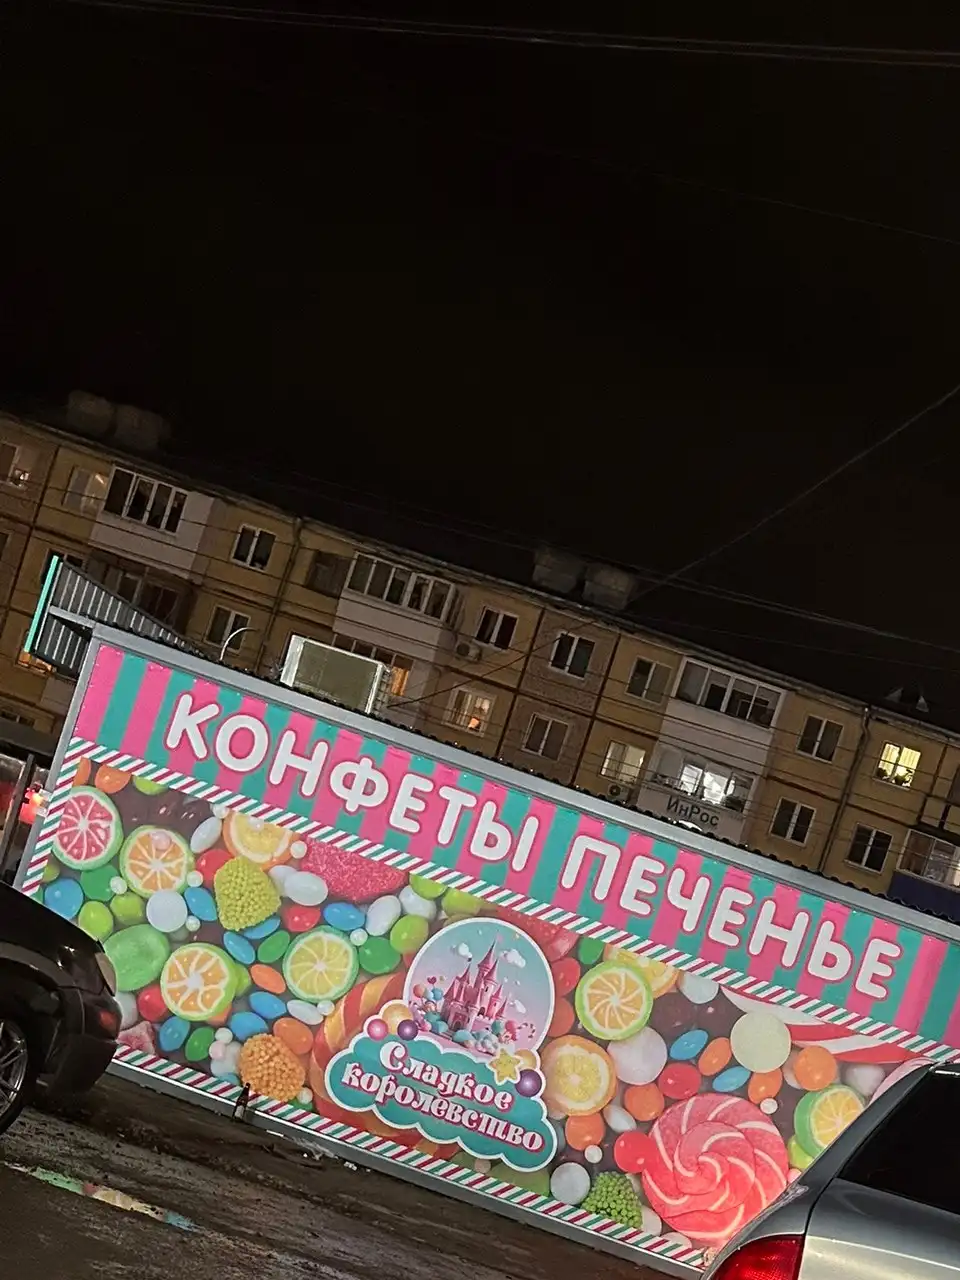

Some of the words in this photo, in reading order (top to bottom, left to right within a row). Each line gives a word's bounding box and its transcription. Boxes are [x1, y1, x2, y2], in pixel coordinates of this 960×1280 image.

[165, 693, 540, 873] КОНФЕТЫ
[560, 834, 902, 1001] ПЕЧЕНЬЕ
[341, 1062, 546, 1152] королевство
[380, 1041, 515, 1111] Сладкое
